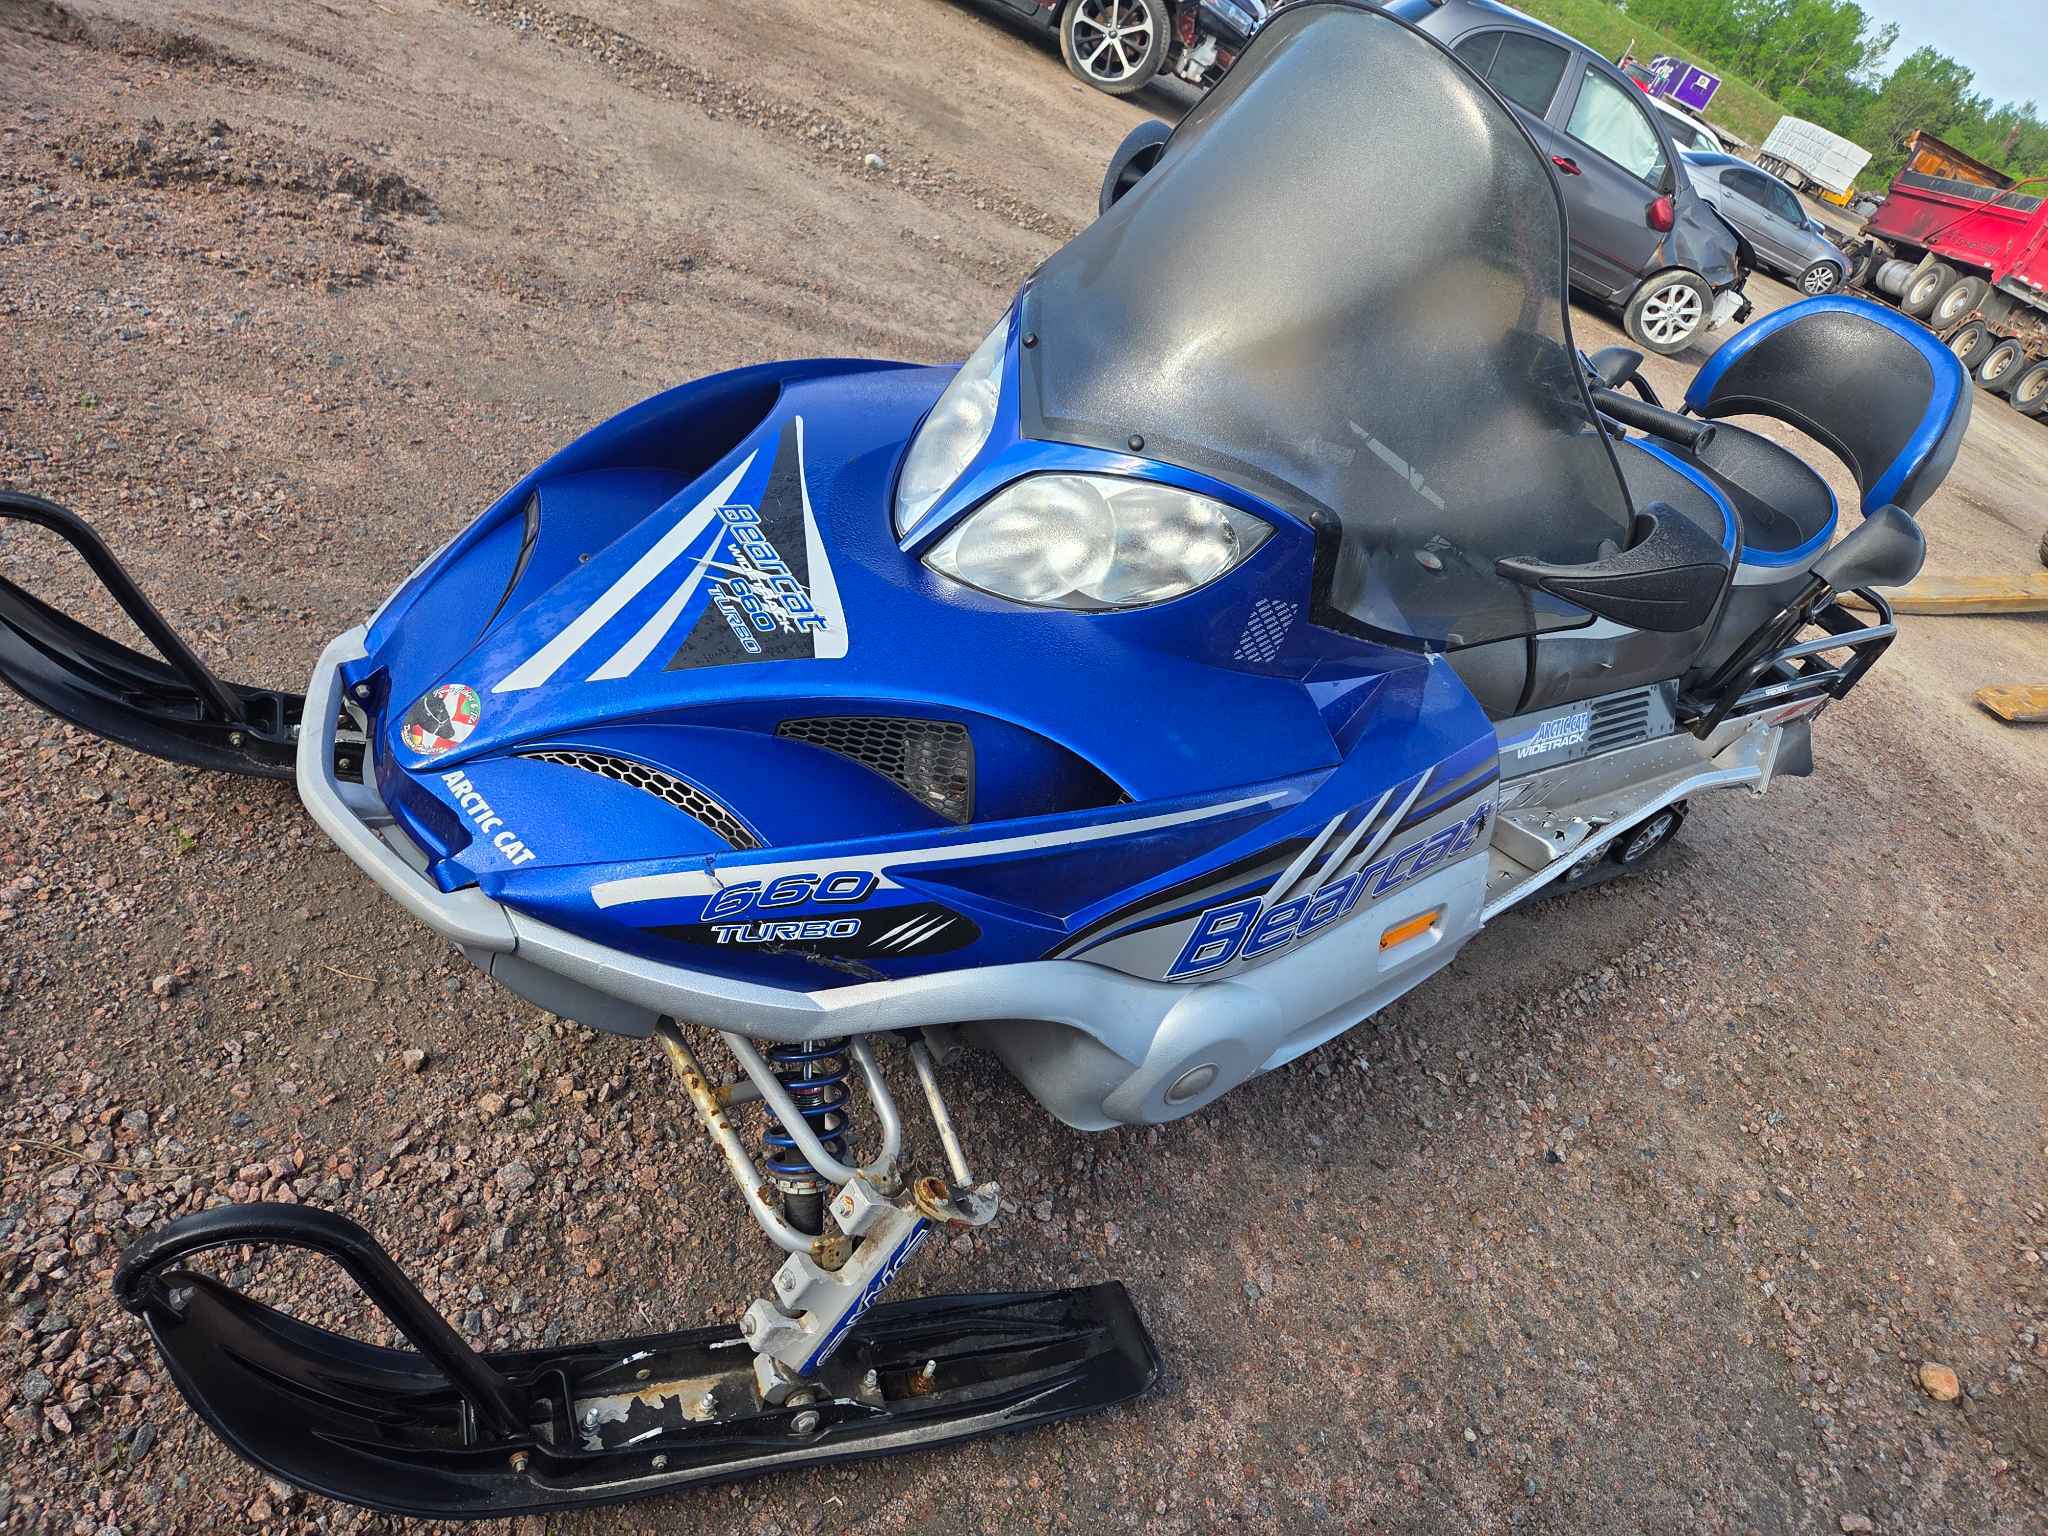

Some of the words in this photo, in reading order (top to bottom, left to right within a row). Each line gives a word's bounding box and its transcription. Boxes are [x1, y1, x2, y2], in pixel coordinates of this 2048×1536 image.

[714, 504, 830, 633] Bearcat
[707, 583, 762, 654] TURBO
[729, 576, 777, 632] 660
[1517, 731, 1586, 760] WIDETRACK
[441, 770, 504, 834] ARCTIC
[493, 830, 537, 865] CAT
[700, 869, 879, 922] 660
[1163, 799, 1490, 982] Bearcat
[711, 917, 862, 944] TURBO
